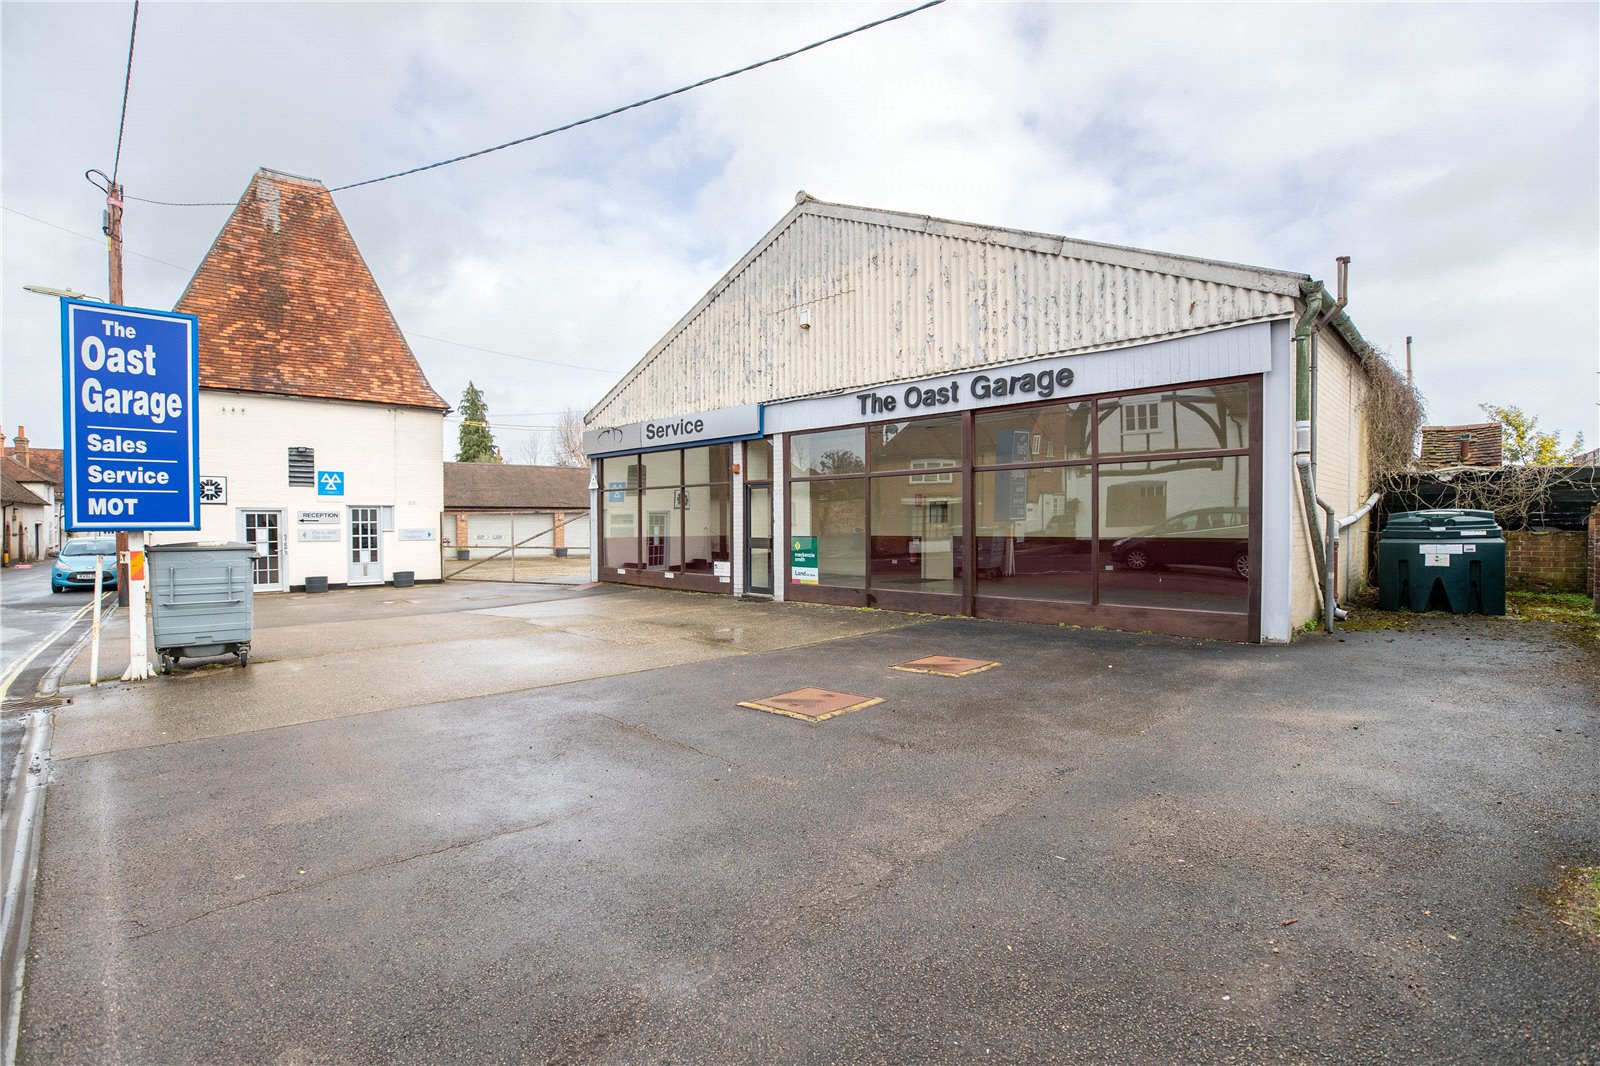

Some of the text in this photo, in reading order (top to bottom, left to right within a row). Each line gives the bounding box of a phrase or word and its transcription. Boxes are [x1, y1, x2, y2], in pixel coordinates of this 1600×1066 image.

[102, 320, 136, 338] The
[81, 335, 156, 376] Oast
[81, 377, 183, 424] Garage
[857, 367, 1074, 415] The Oast Garage
[646, 419, 704, 440] Service
[87, 433, 148, 454] Sales
[87, 465, 170, 484] Service
[88, 498, 139, 515] MOT
